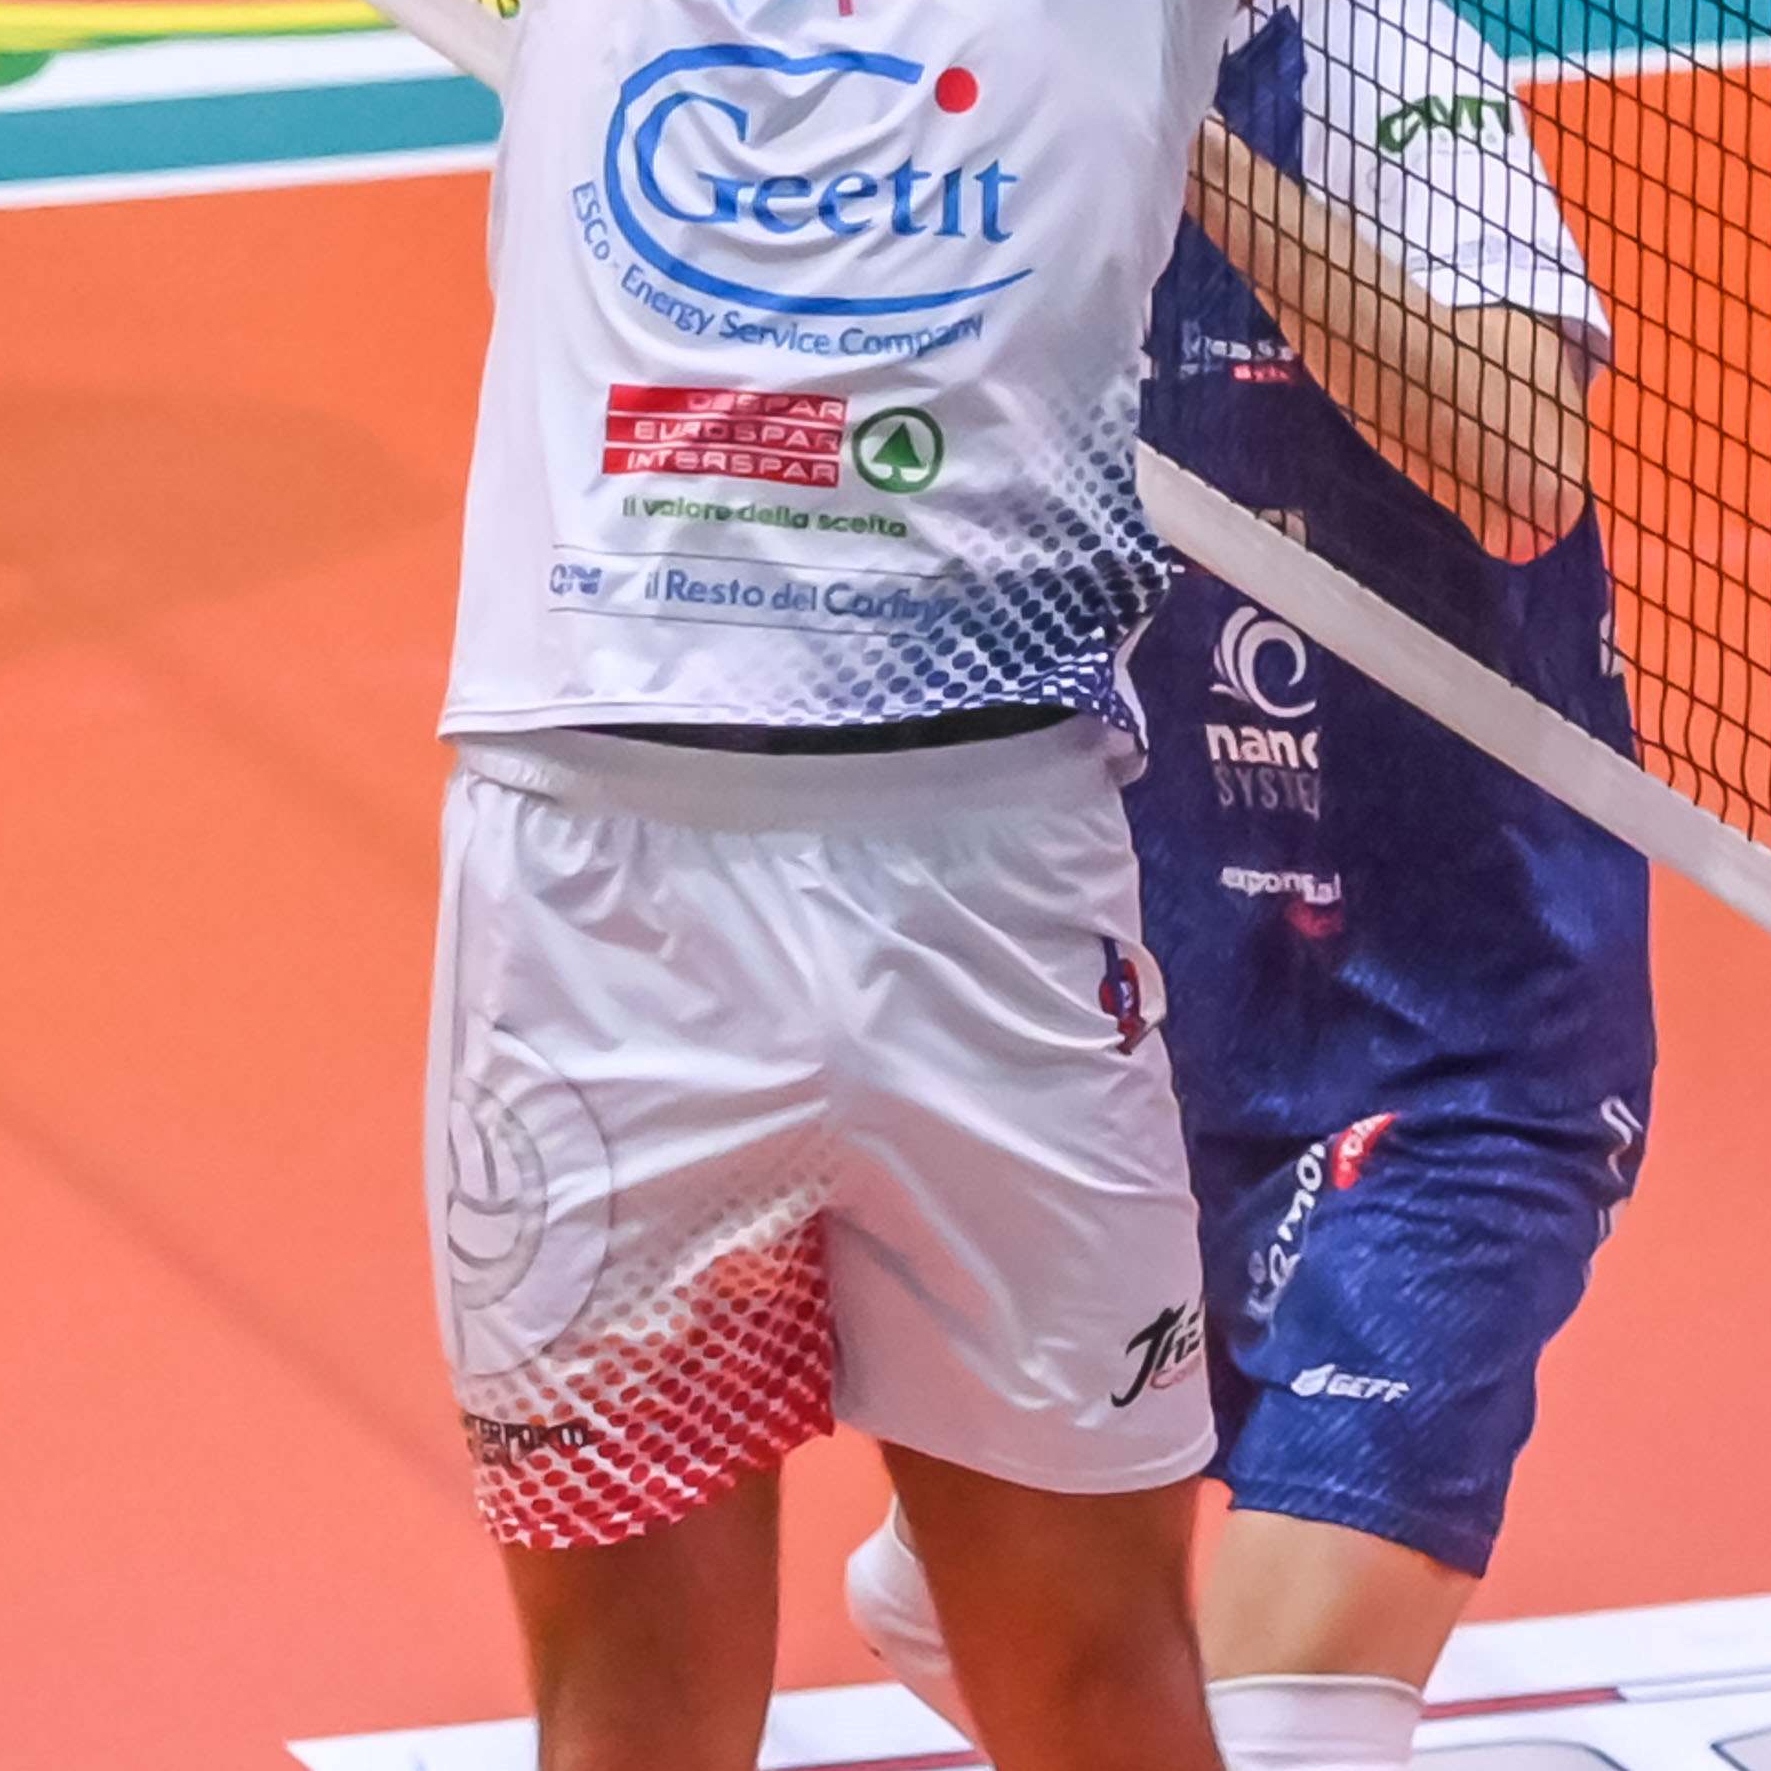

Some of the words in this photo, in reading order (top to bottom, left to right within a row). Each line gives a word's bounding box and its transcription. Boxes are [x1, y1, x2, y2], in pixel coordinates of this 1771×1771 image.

[621, 264, 715, 336] Energy
[717, 311, 830, 356] Service
[837, 313, 985, 358] Company
[627, 449, 837, 483] INTERSPAR
[736, 503, 810, 529] della
[817, 512, 908, 538] scelta
[665, 569, 765, 608] Resto
[771, 582, 818, 612] del
